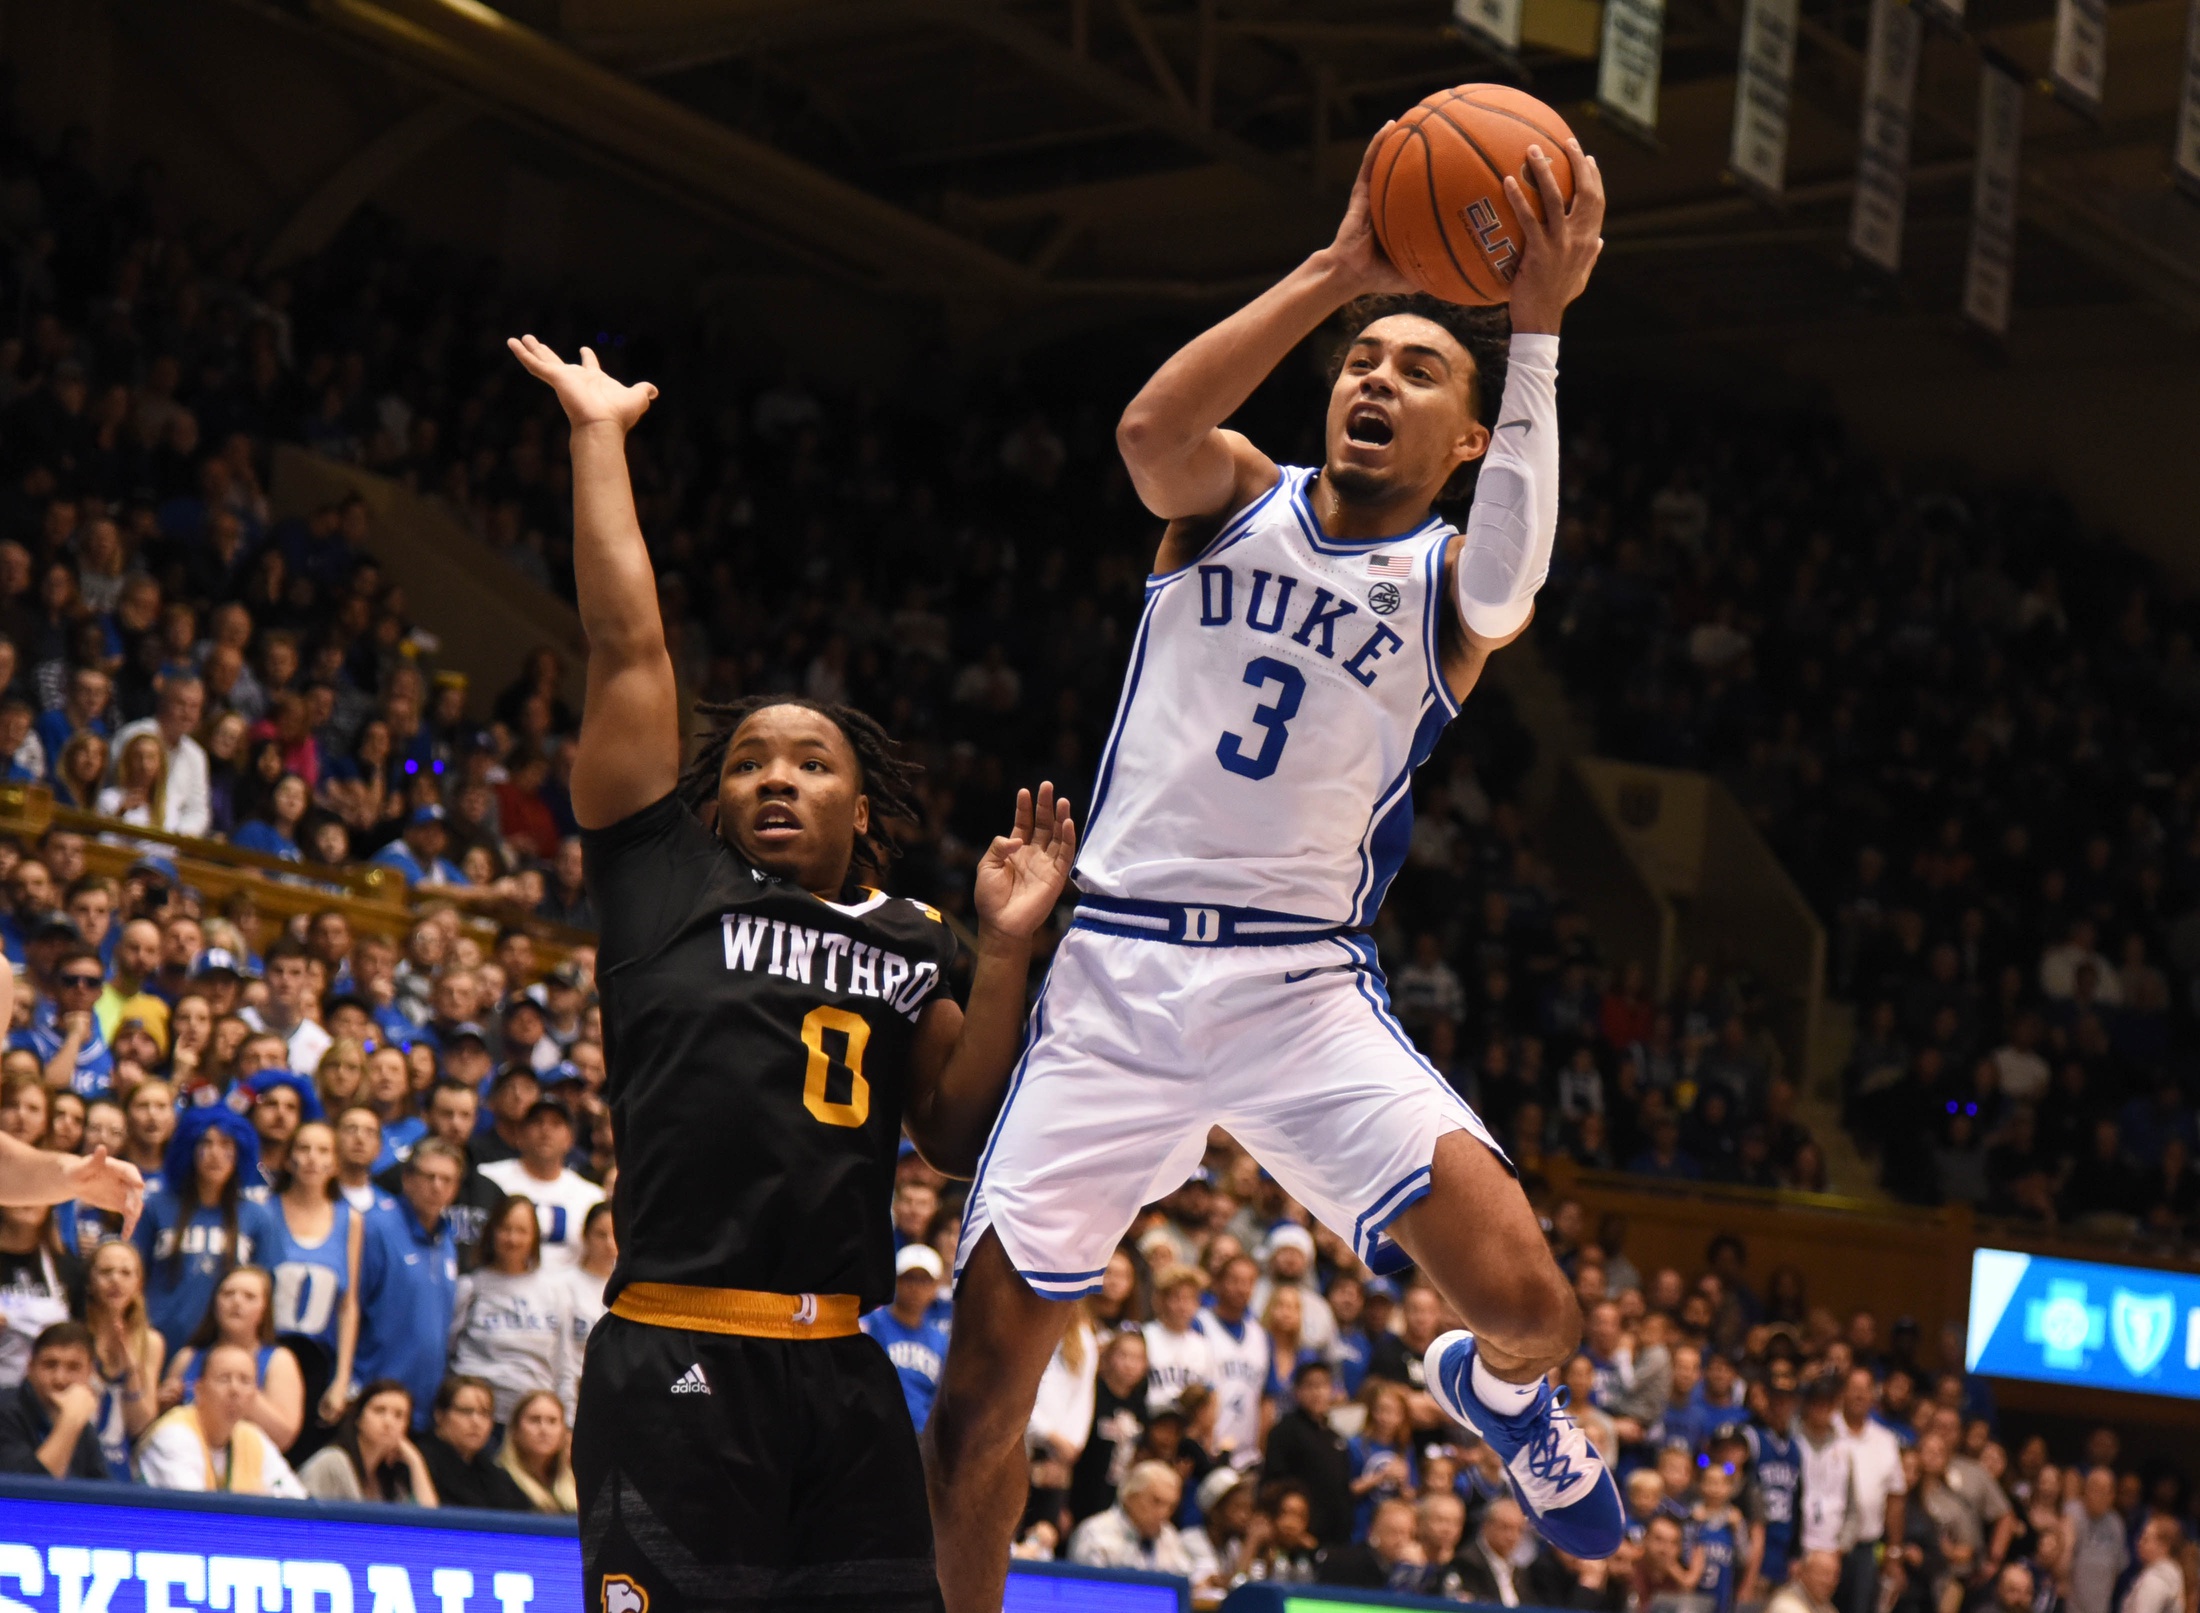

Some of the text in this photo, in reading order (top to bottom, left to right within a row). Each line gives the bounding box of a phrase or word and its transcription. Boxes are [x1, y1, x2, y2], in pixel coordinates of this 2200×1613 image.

[1198, 564, 1404, 688] DUKE
[1370, 592, 1400, 605] ACC
[1215, 655, 1306, 781] 3
[801, 1005, 871, 1128] 0
[671, 1382, 711, 1396] adidas
